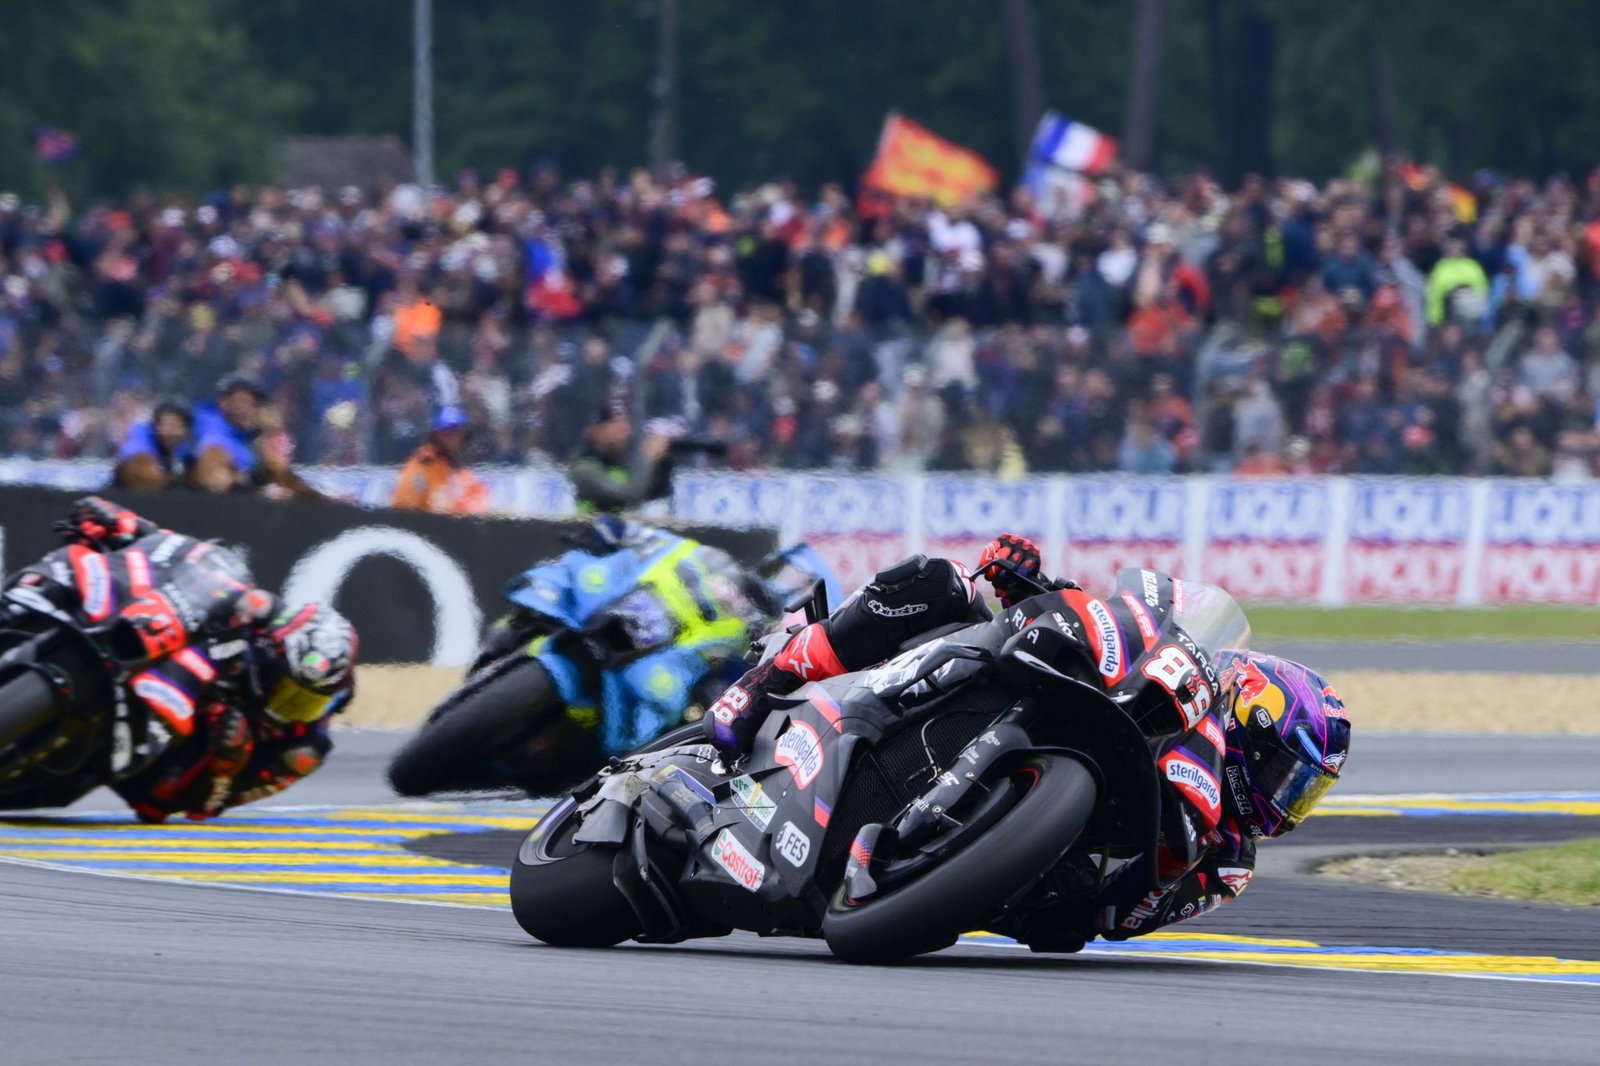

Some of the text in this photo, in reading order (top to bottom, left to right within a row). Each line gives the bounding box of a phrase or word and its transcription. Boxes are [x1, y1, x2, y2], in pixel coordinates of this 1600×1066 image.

[1069, 483, 1182, 535] LIQUI
[1212, 484, 1326, 536] LIQUI
[1353, 485, 1466, 538] LIQUI
[1349, 547, 1464, 599] MOLY
[1090, 601, 1121, 673] sterilgarda
[780, 727, 820, 779] sterilgarda
[1170, 762, 1219, 805] sterilgarda
[786, 831, 807, 862] FES
